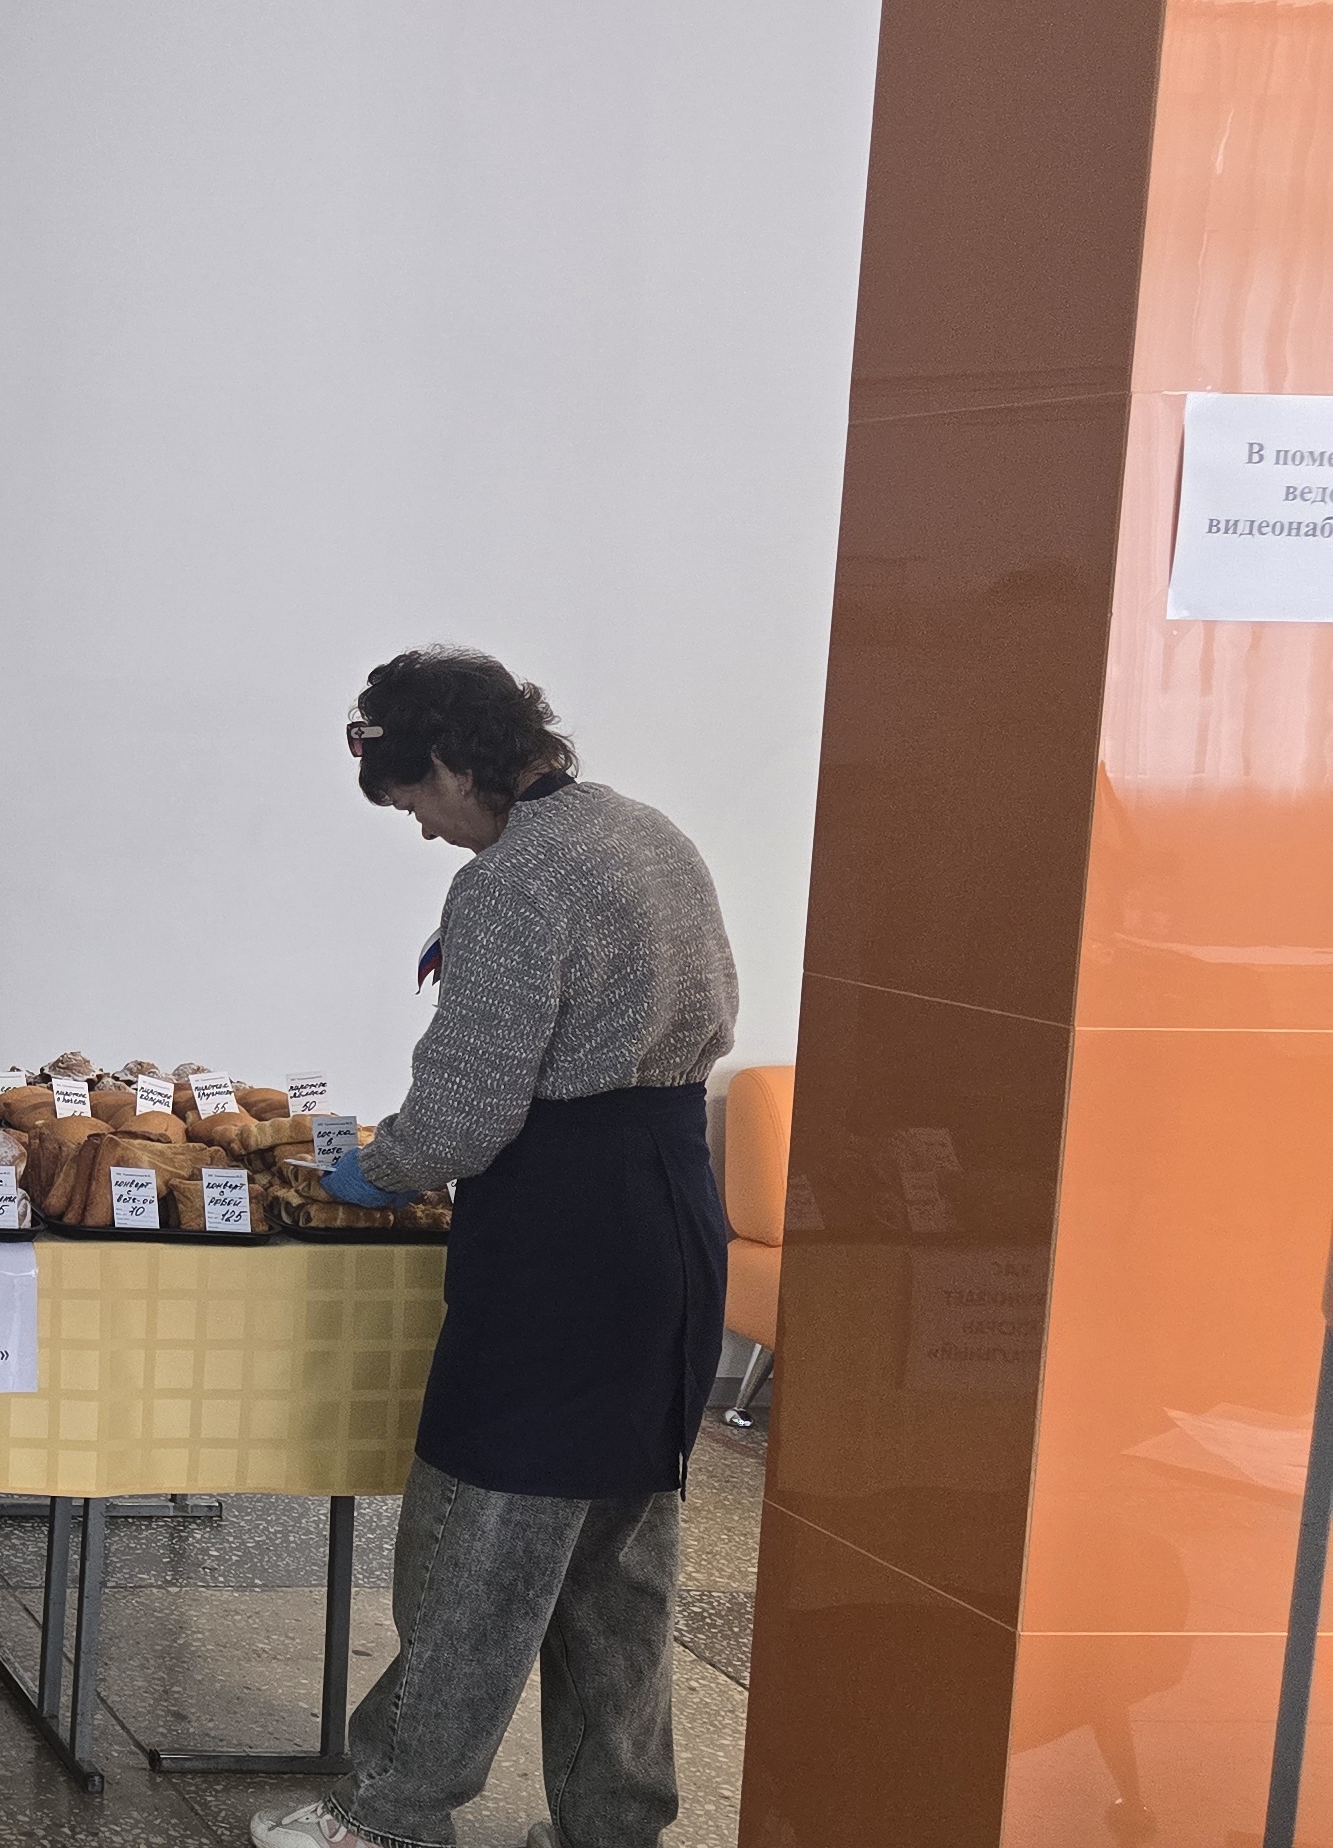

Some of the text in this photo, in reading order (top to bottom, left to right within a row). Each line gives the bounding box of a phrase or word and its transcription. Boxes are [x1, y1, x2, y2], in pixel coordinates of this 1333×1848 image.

[1245, 441, 1265, 465] В
[1206, 516, 1333, 538] видеонаб
[212, 1102, 228, 1114] 55
[301, 1100, 317, 1113] 50
[220, 1208, 248, 1223] 125
